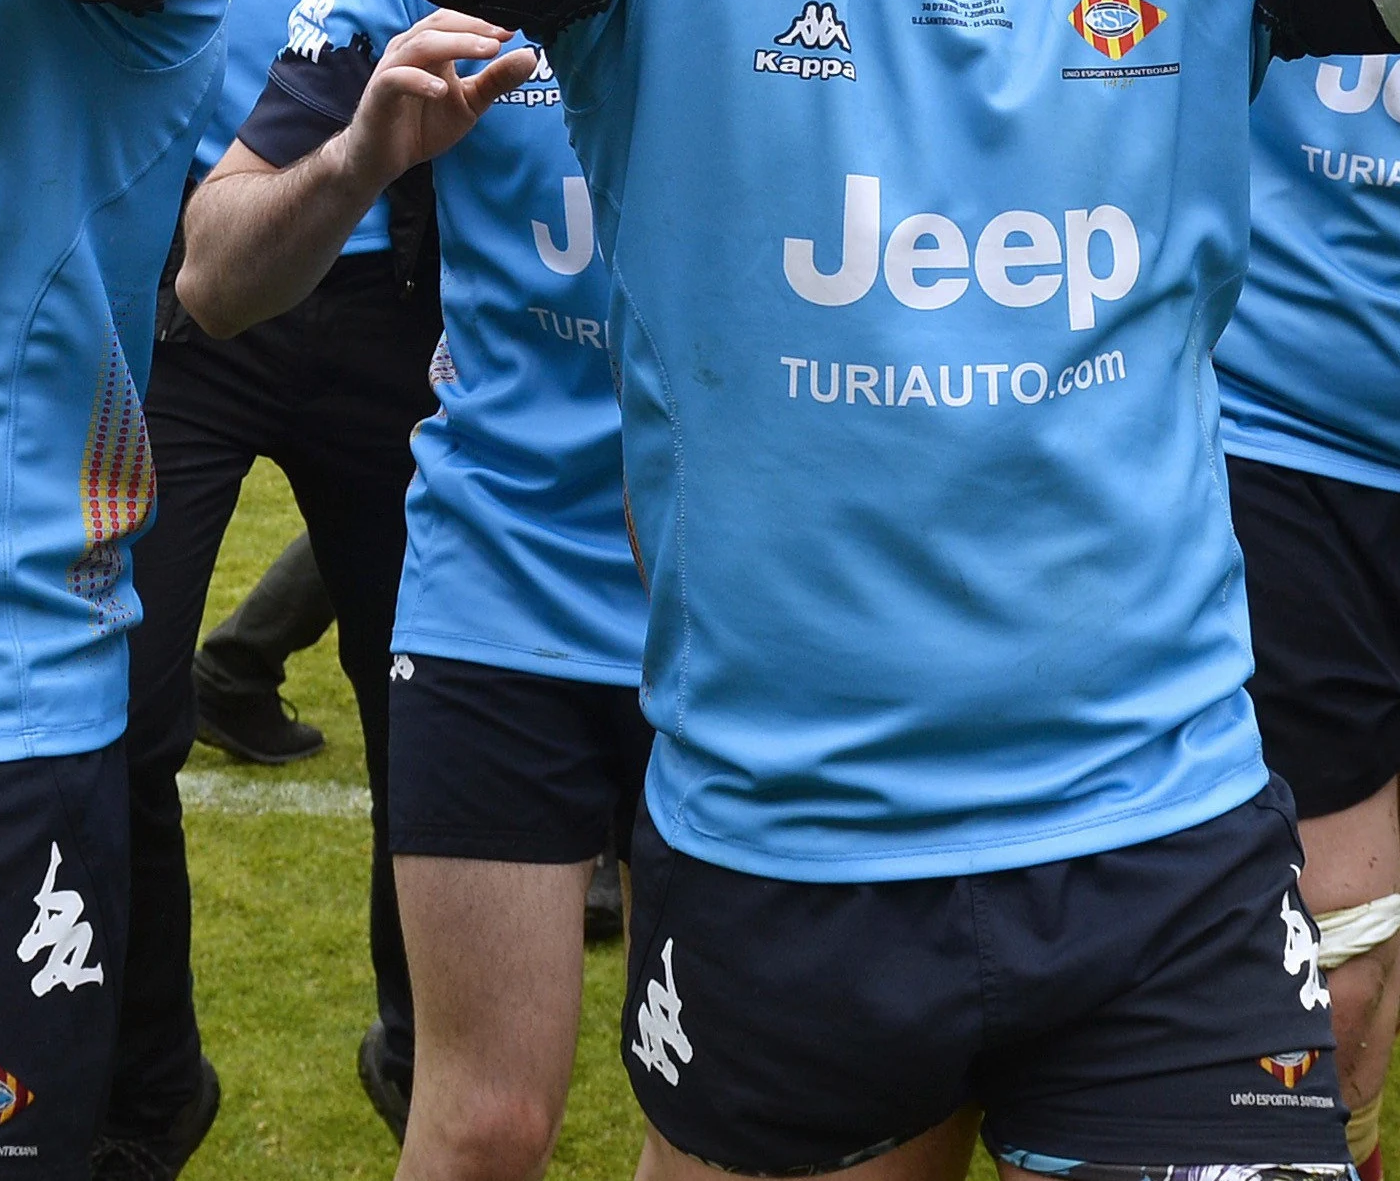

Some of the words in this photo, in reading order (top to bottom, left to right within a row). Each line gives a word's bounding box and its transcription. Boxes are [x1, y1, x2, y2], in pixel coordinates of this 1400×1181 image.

[754, 50, 856, 81] Kappa
[783, 173, 1140, 331] Jeep
[780, 348, 1126, 407] TURIAUTO.com
